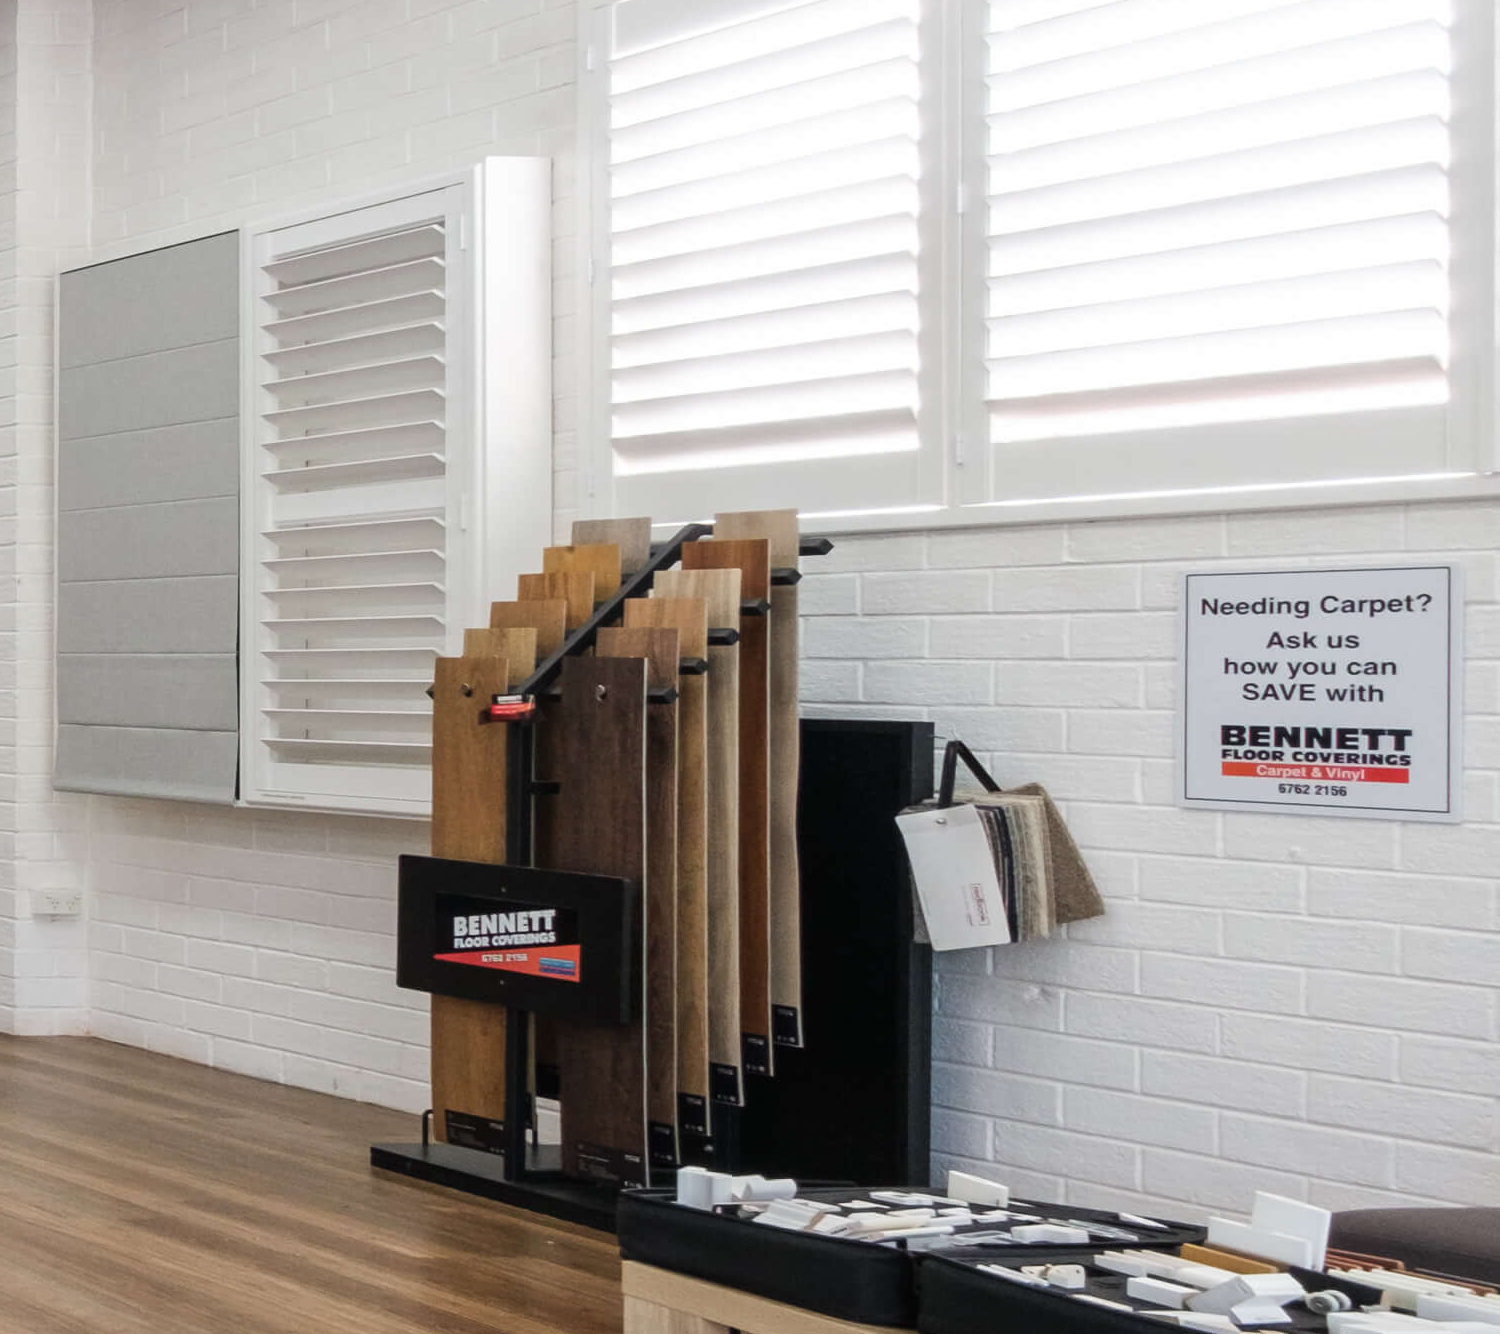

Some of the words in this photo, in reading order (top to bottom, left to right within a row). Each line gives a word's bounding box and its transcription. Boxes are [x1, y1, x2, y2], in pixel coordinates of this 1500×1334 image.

[1201, 598, 1310, 618] Needing
[1320, 593, 1433, 617] Carpet?
[1266, 631, 1318, 649] Ask
[1327, 634, 1360, 649] us
[1224, 658, 1278, 675] how
[1287, 661, 1337, 679] you
[1346, 661, 1397, 676] can
[1242, 683, 1317, 701] SAVE
[1326, 684, 1385, 702] with
[1221, 724, 1412, 751] BENNETT
[1221, 749, 1285, 762] FLOOR
[1292, 751, 1411, 766] COVERINGS
[1256, 764, 1306, 779] Carpet
[1310, 768, 1322, 778] &
[1326, 768, 1365, 782] Vinyl
[453, 909, 556, 937] BENNETT
[454, 936, 490, 948] FLOOR
[492, 931, 556, 946] COVERINGS
